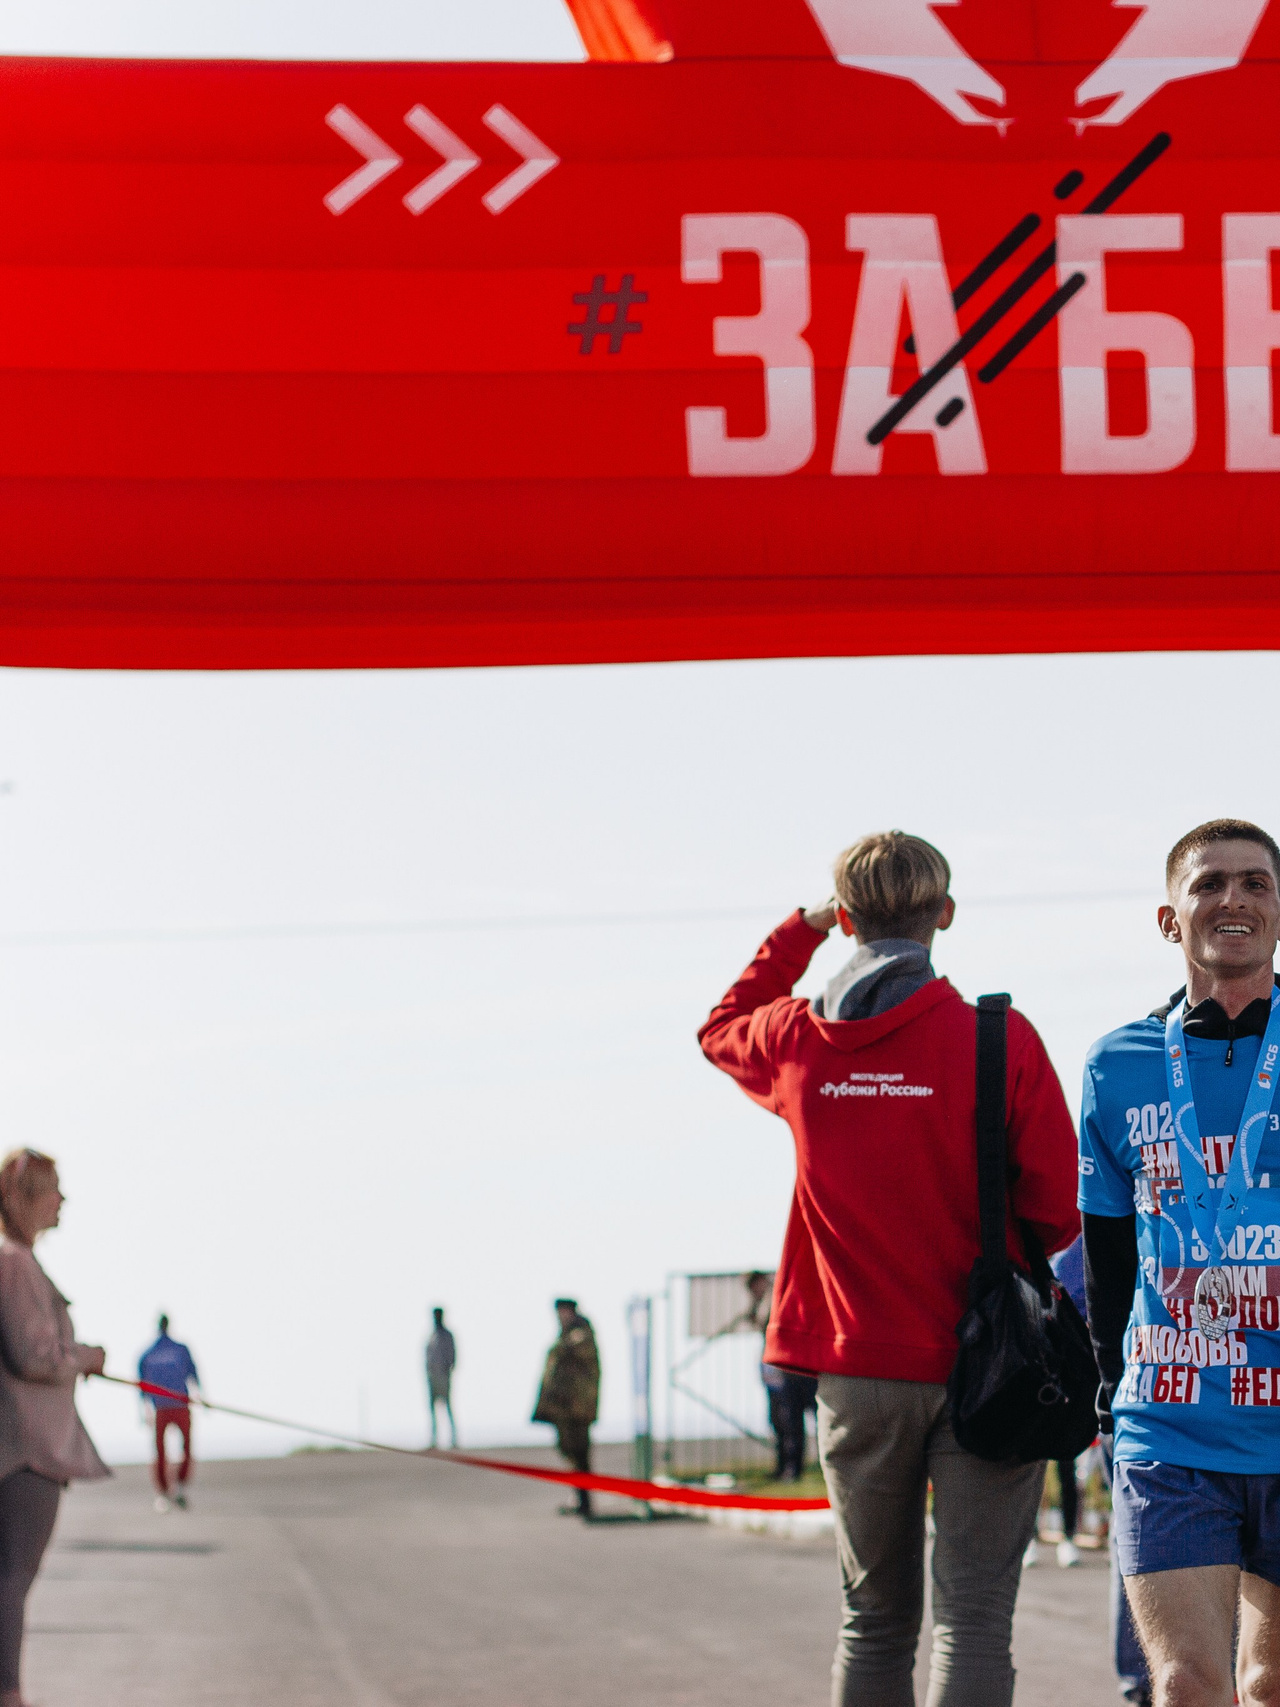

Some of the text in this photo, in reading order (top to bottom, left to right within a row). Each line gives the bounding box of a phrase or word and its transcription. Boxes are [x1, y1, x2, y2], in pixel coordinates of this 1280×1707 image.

[1263, 1044, 1279, 1072] ПСБ
[1171, 1060, 1184, 1088] ПСБ
[1125, 1101, 1175, 1147] 202
